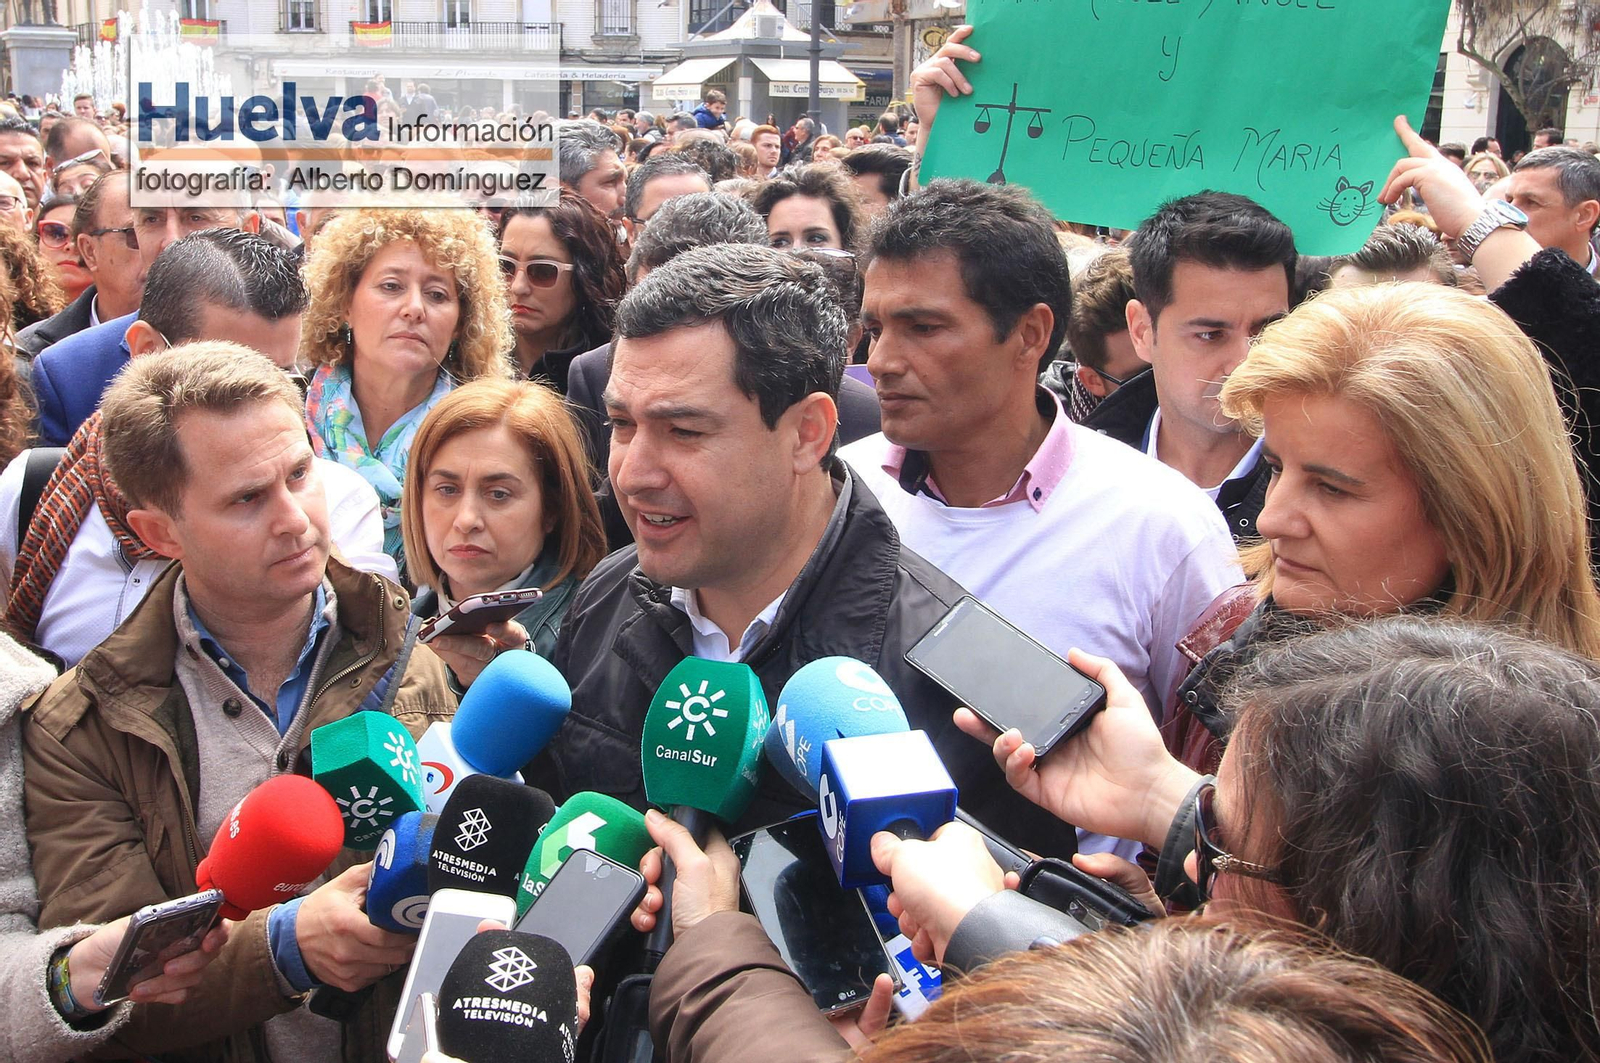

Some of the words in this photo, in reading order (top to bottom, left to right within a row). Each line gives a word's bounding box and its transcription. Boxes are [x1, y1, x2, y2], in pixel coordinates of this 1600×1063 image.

[1062, 115, 1204, 170] PEQUEÑA
[655, 744, 718, 768] CanalSur
[836, 810, 846, 863] COPE
[432, 849, 497, 877] ATRESMEDIA
[437, 861, 485, 883] TELEVISIÓN
[846, 989, 857, 998] LG
[452, 997, 548, 1023] ATRESMEDIA
[463, 1009, 534, 1029] TELEVISIÓN
